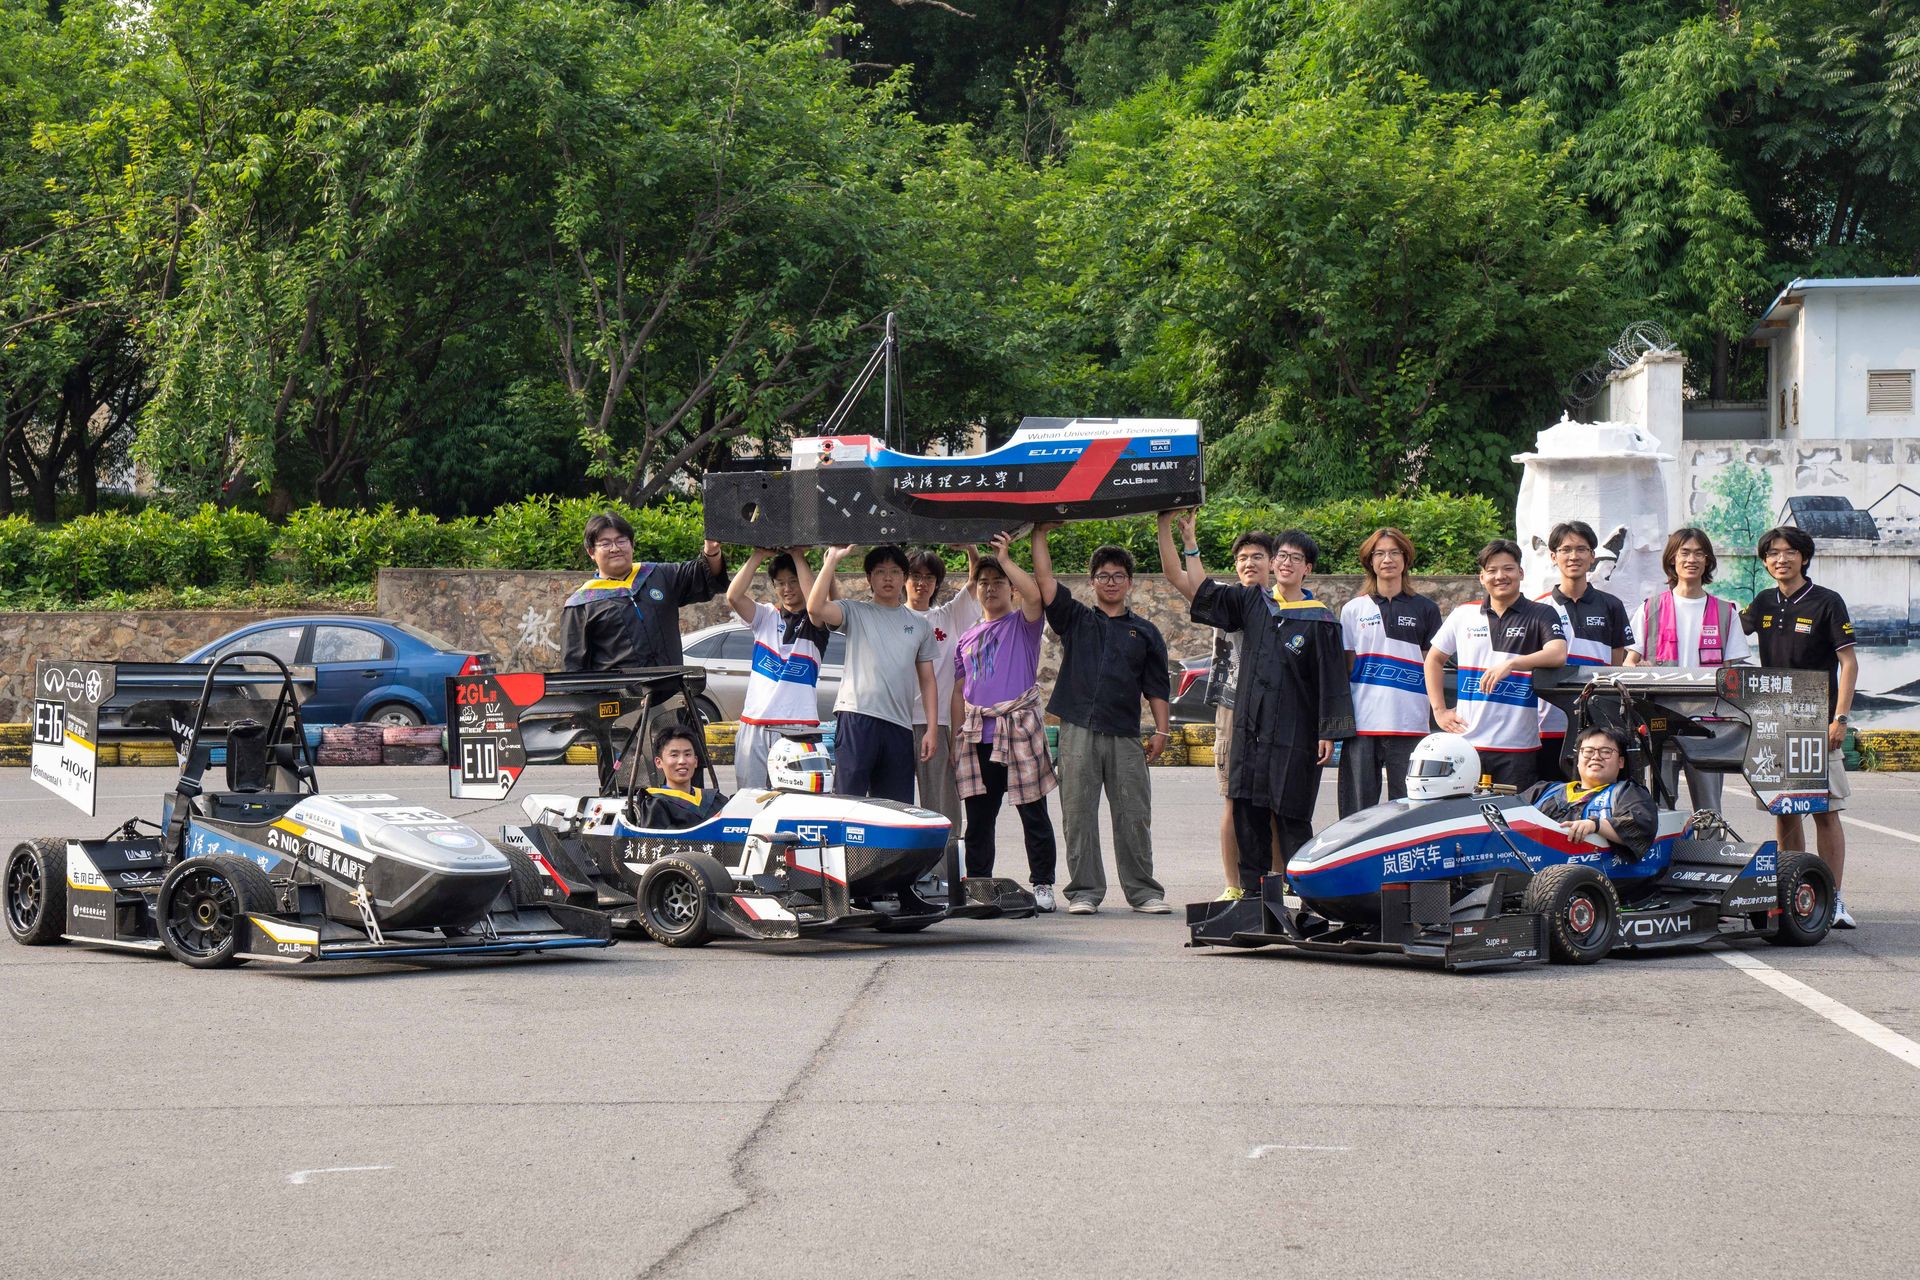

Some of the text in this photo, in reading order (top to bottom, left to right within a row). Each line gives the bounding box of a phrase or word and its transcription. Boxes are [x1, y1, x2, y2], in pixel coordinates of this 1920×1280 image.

[1028, 432, 1061, 440] Wuhan
[1063, 430, 1110, 438] University
[1126, 426, 1179, 435] Technology
[1131, 461, 1179, 471] ONE KART
[1113, 478, 1143, 486] CALB
[66, 680, 84, 689] NISSAN
[1748, 674, 1793, 694] 中复神鹰
[456, 683, 488, 705] ZGL
[35, 704, 64, 743] E36
[1757, 722, 1779, 733] SMT
[463, 744, 495, 779] E10
[1789, 738, 1822, 773] E03
[60, 756, 92, 784] HIOKI
[1794, 801, 1810, 811] NIO
[281, 833, 300, 853] NIO
[308, 842, 367, 882] ONE KART
[1383, 844, 1441, 876] 岚图汽车
[1567, 853, 1601, 864] EVE
[74, 872, 102, 885] 东风日产
[1756, 875, 1777, 883] CALB
[1618, 915, 1691, 936] VOYAH
[277, 943, 300, 952] CALB
